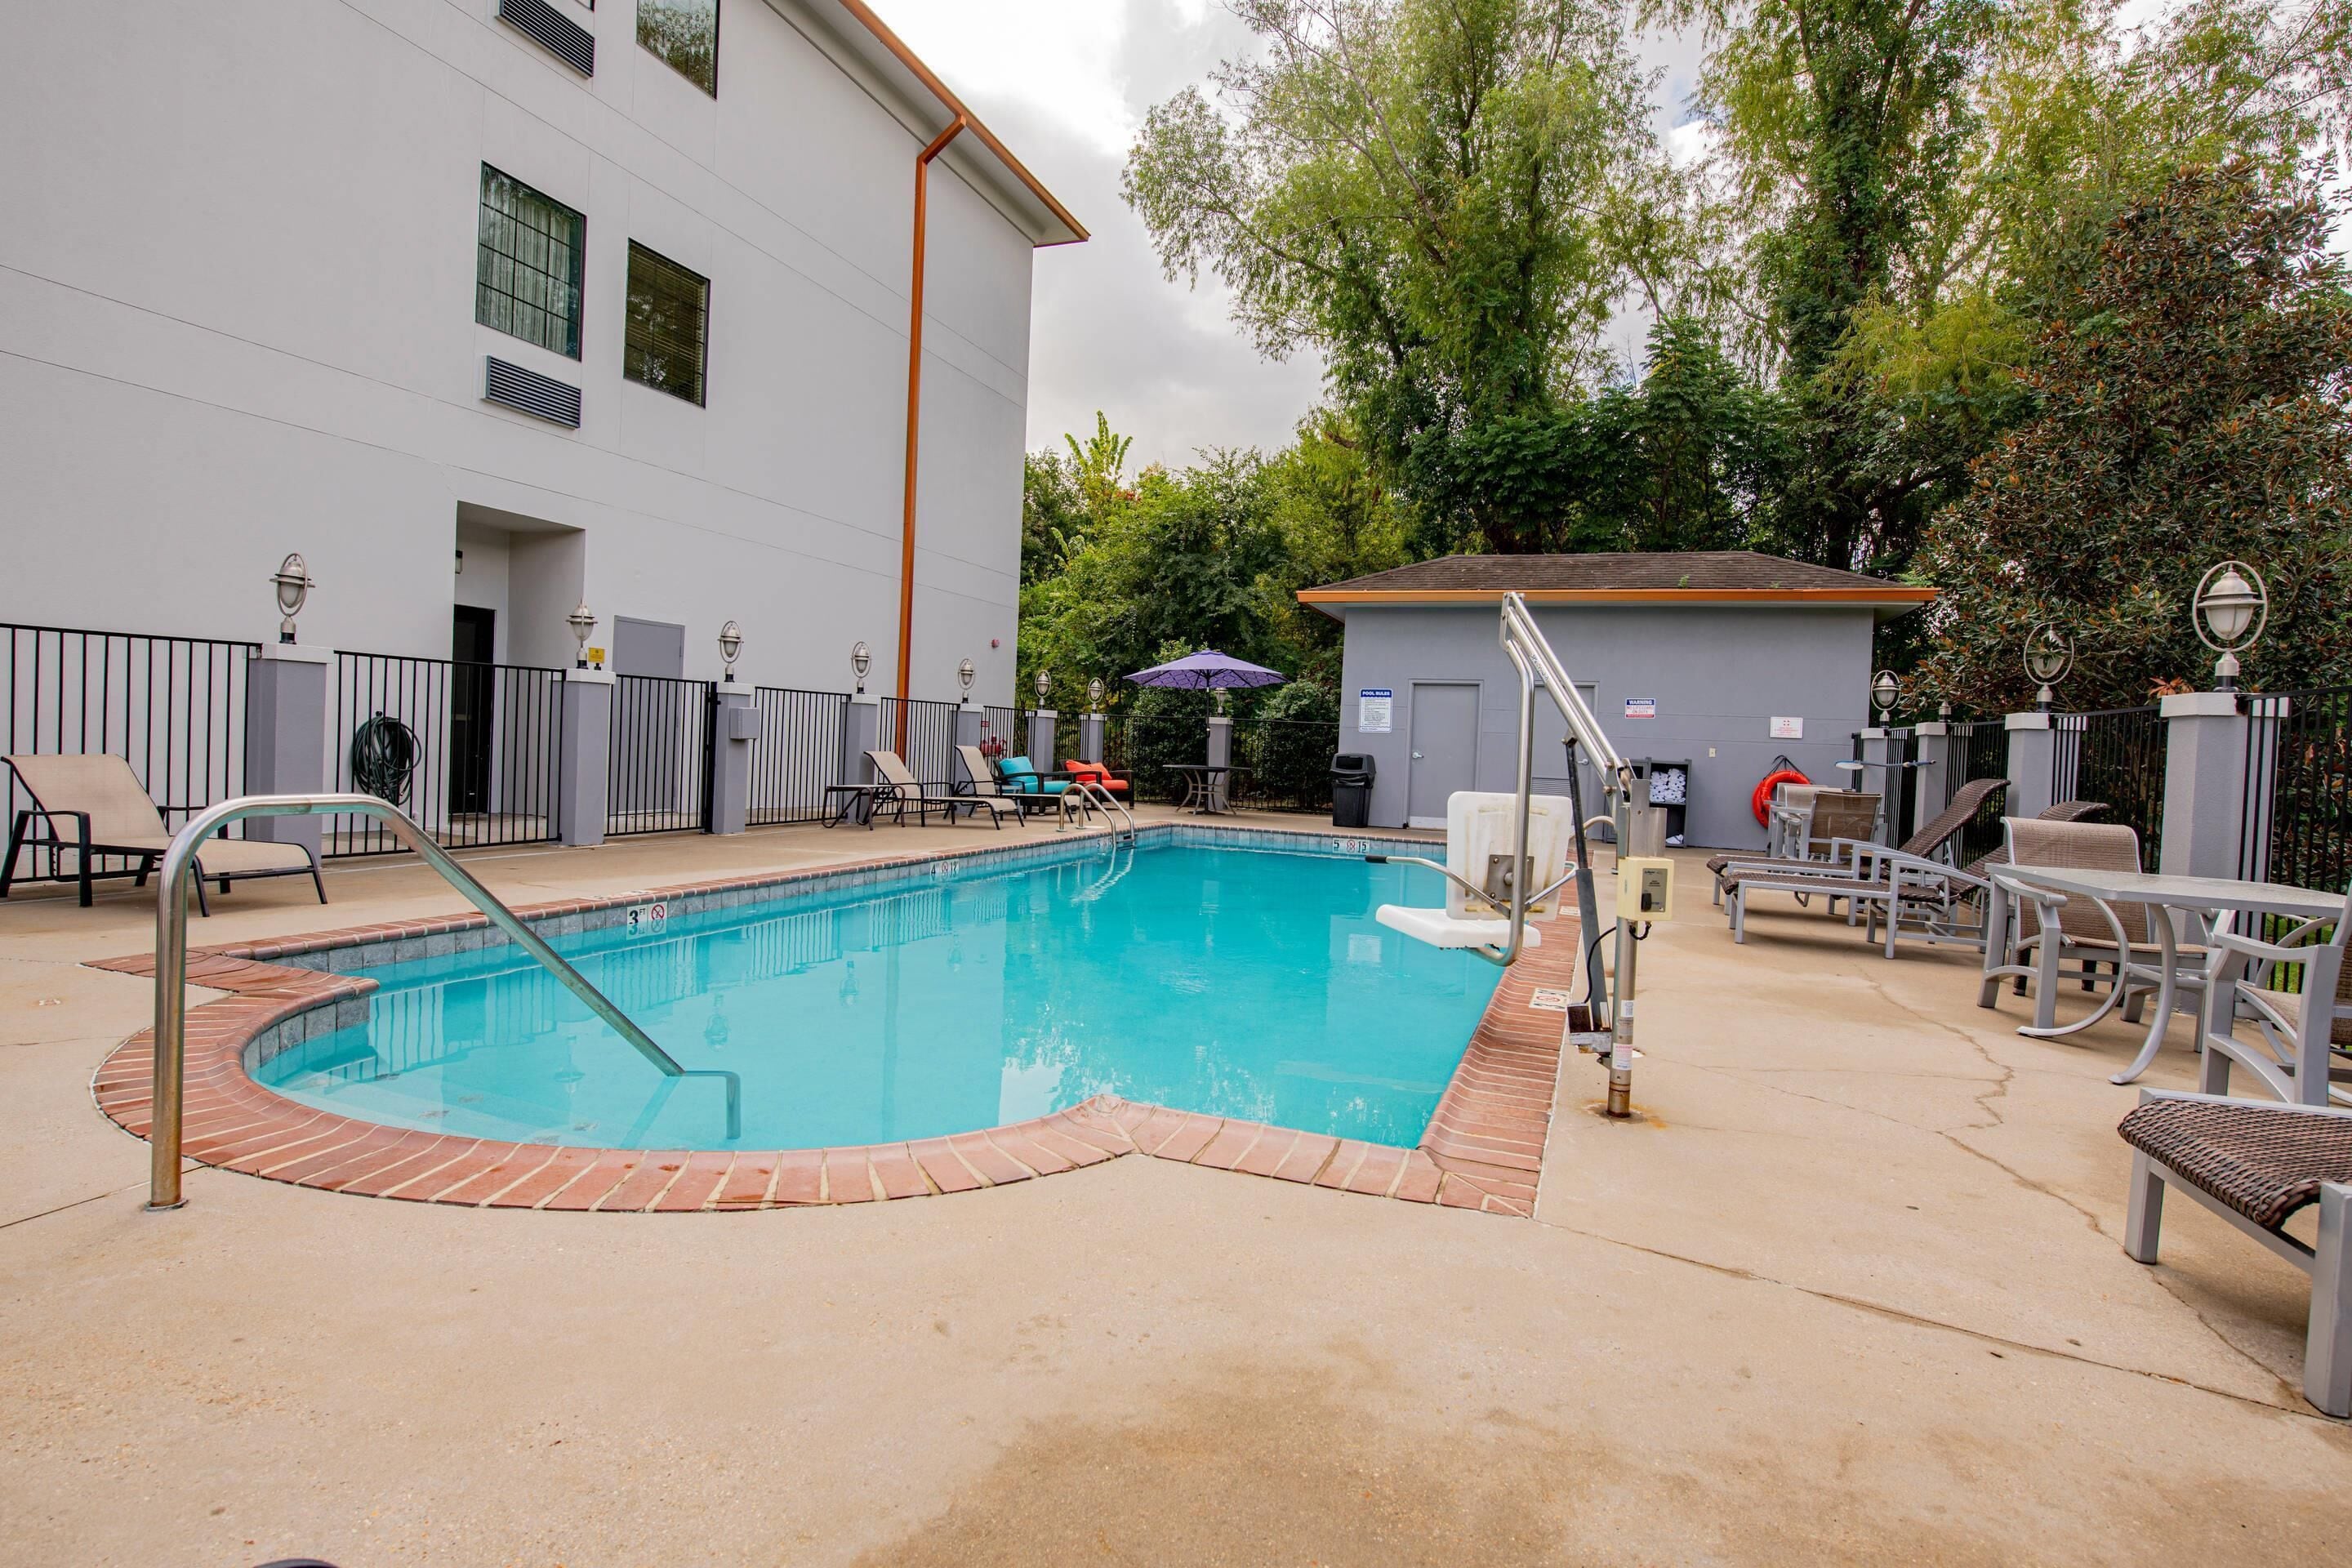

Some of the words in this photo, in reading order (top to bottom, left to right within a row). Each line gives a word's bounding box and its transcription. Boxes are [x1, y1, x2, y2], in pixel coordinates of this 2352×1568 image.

[1334, 840, 1339, 849] 5
[931, 864, 936, 874] 4
[630, 910, 639, 924] 3
